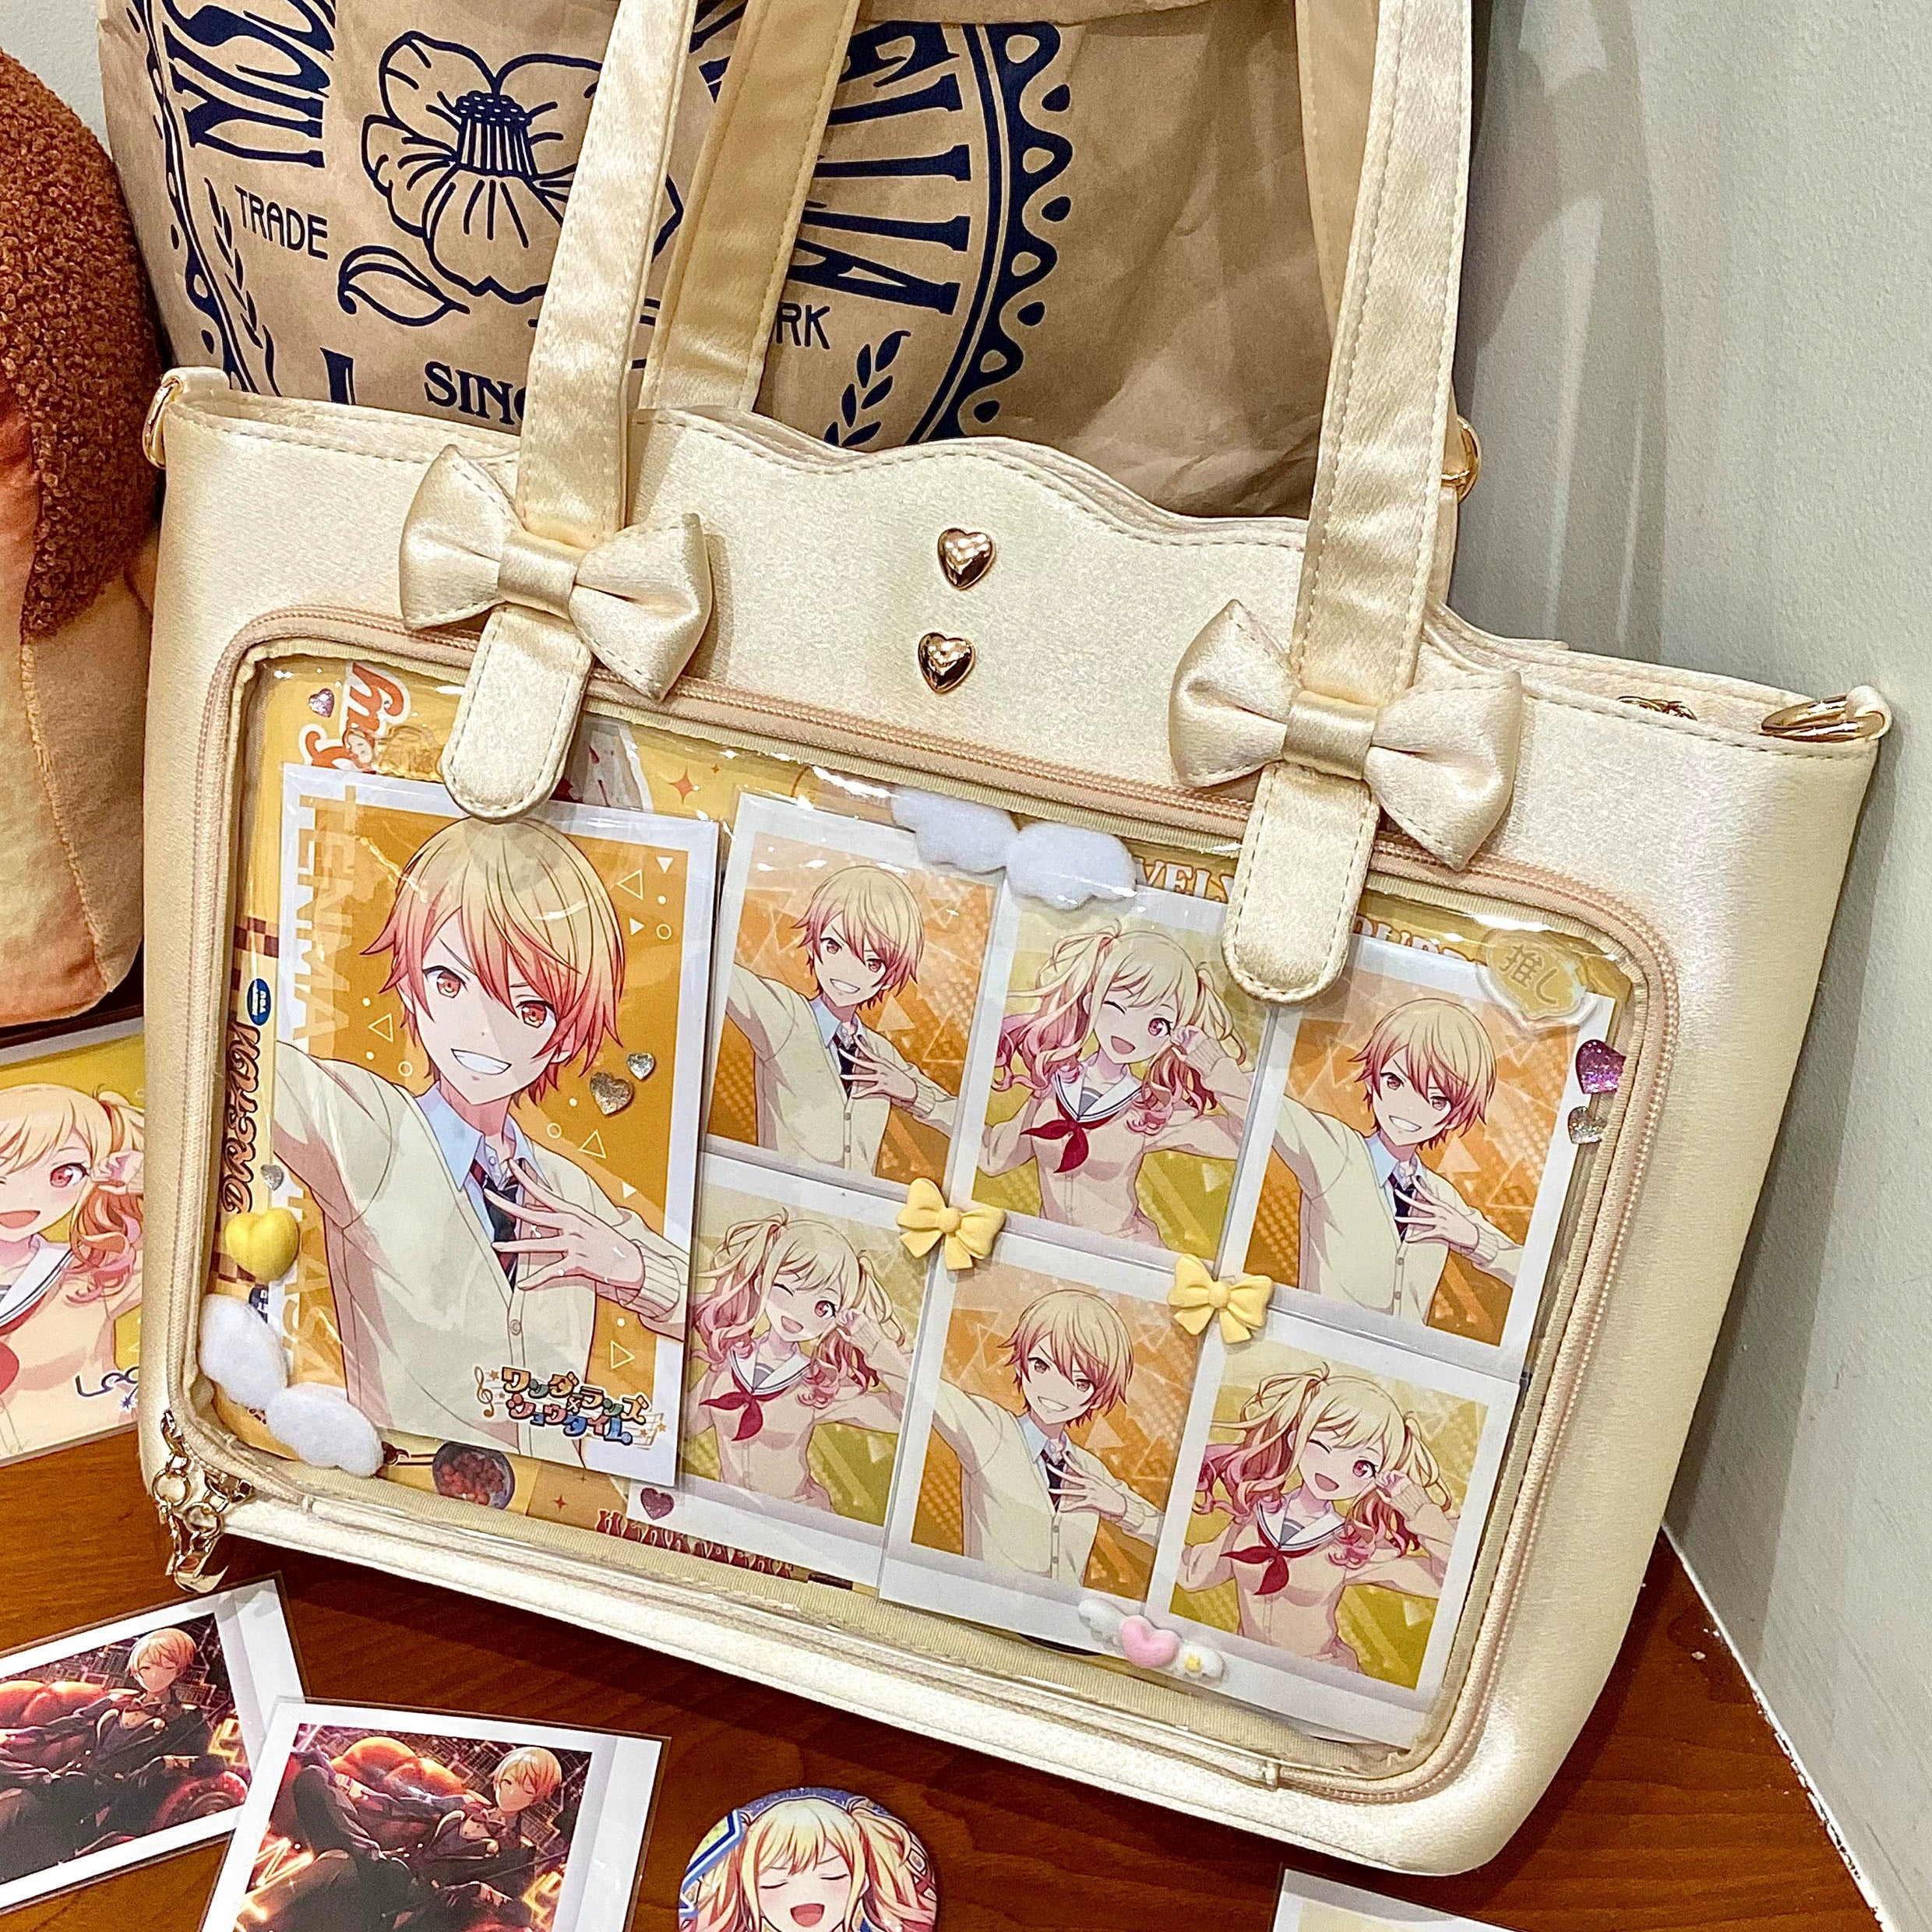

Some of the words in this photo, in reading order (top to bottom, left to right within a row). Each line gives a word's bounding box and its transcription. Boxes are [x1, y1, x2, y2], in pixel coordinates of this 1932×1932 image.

[234, 185, 328, 259] TRADE
[775, 301, 830, 350] RK
[293, 785, 357, 1040] TENMA
[1498, 943, 1559, 1005] 推し
[219, 1021, 261, 1215] DREAM
